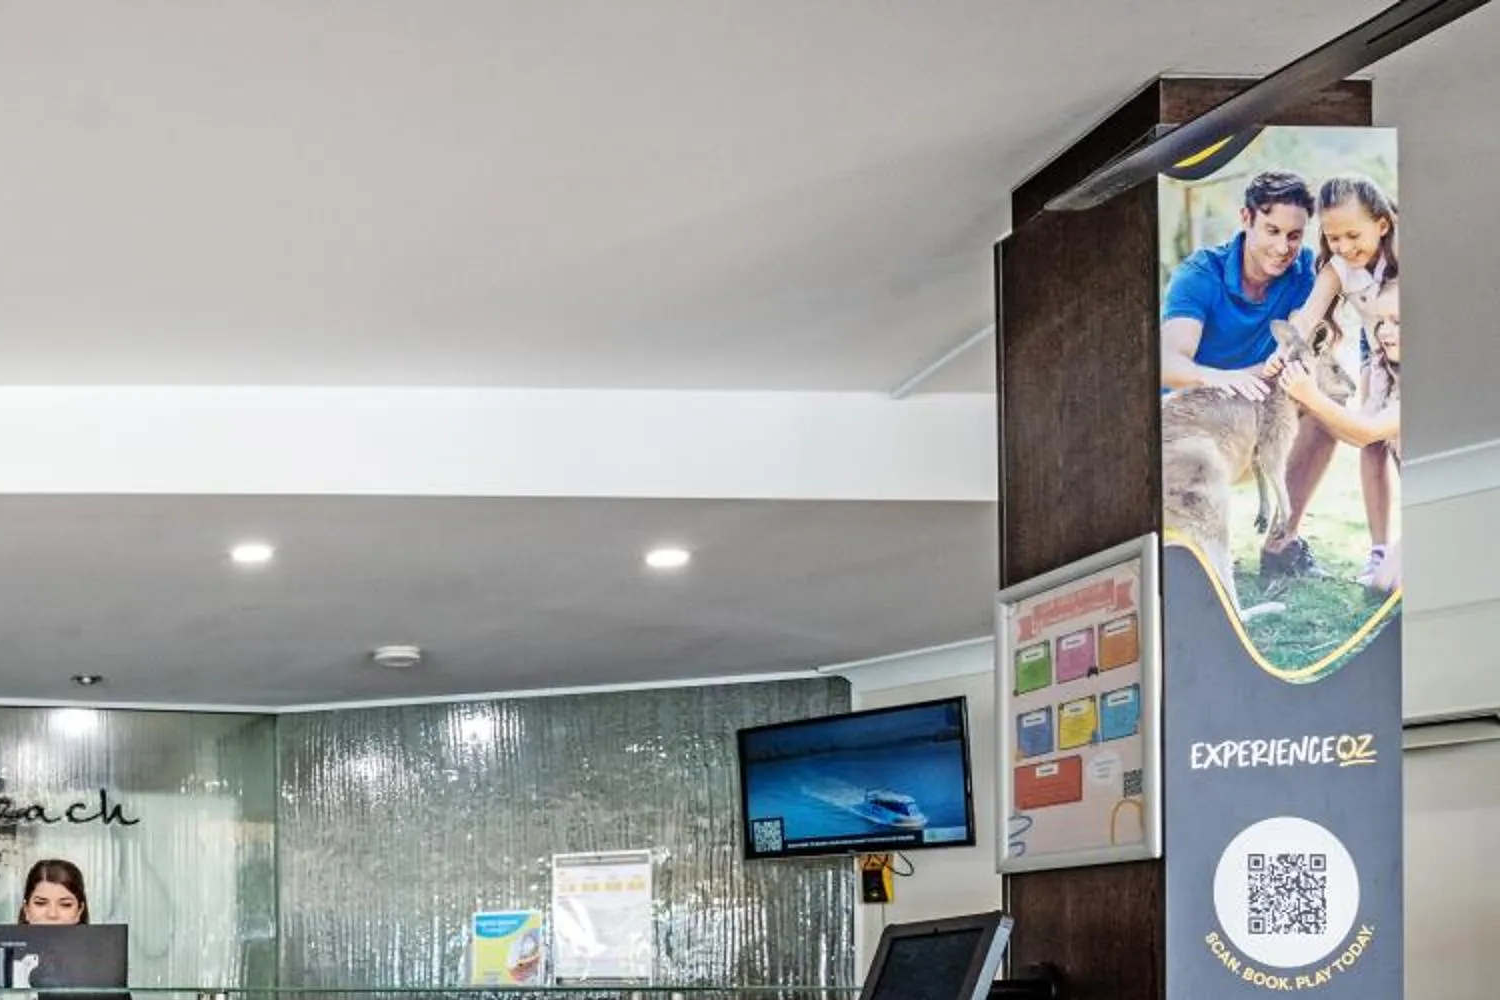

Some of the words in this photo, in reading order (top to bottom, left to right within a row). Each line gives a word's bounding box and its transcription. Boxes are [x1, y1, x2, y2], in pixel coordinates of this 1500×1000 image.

[1205, 932, 1241, 974] SCAN.
[1243, 967, 1293, 990] BOOK.
[1296, 968, 1333, 990] PLAY
[1332, 924, 1375, 972] TODAY.
